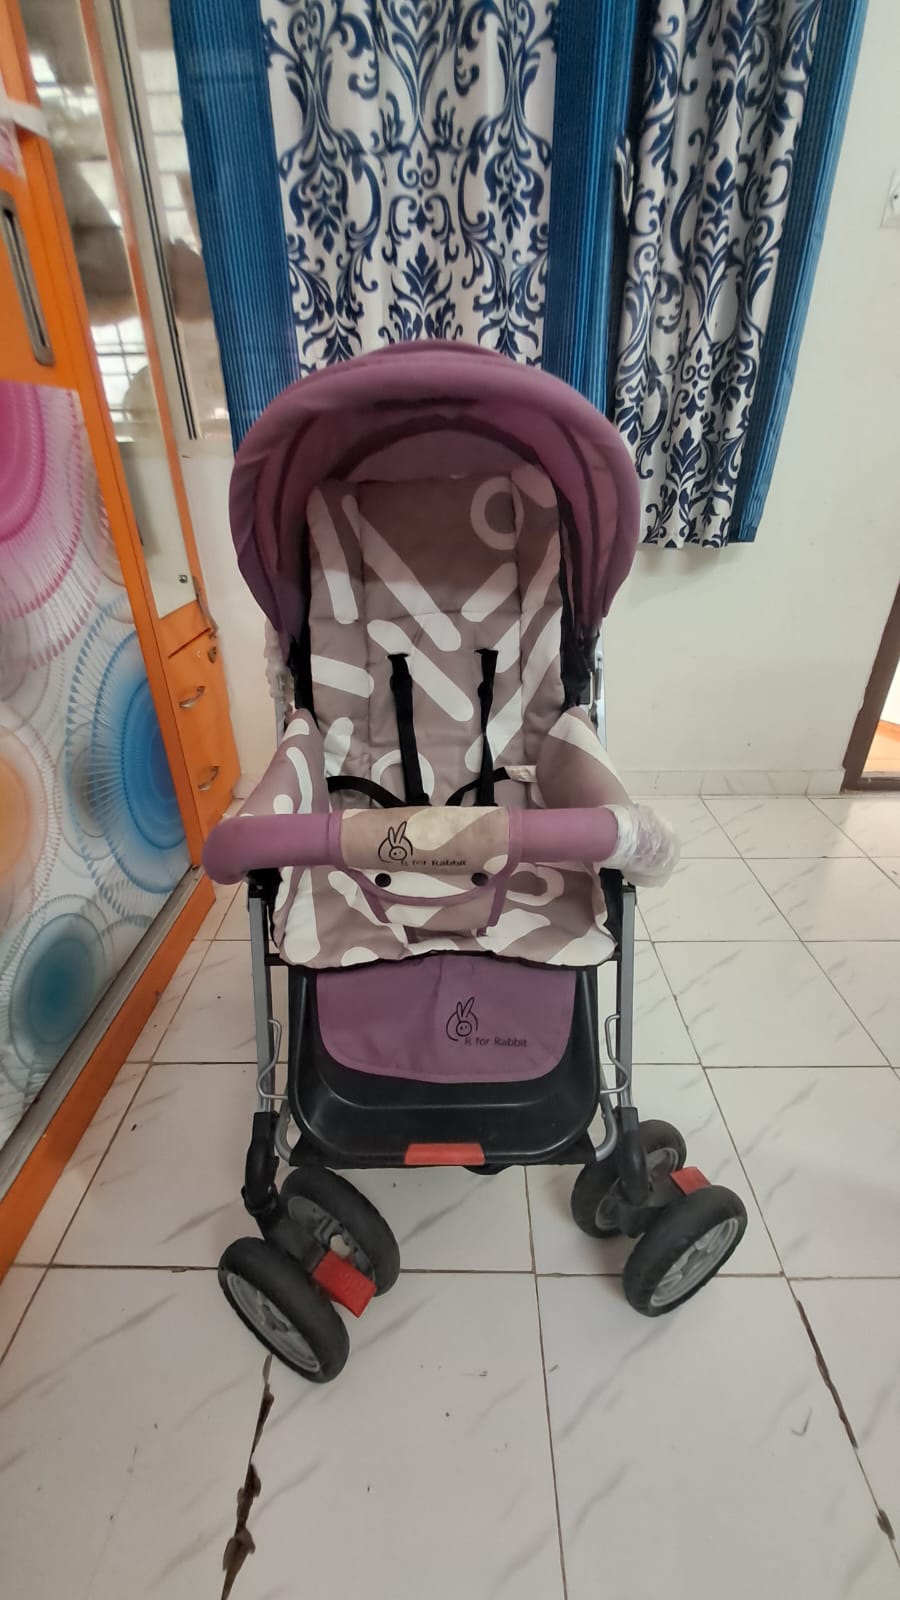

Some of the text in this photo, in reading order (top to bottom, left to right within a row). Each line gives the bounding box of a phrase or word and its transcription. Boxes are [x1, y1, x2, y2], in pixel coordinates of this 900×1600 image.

[412, 859, 426, 867] for
[431, 859, 466, 867] Rabbit
[464, 1037, 527, 1048] R for Rabbit
